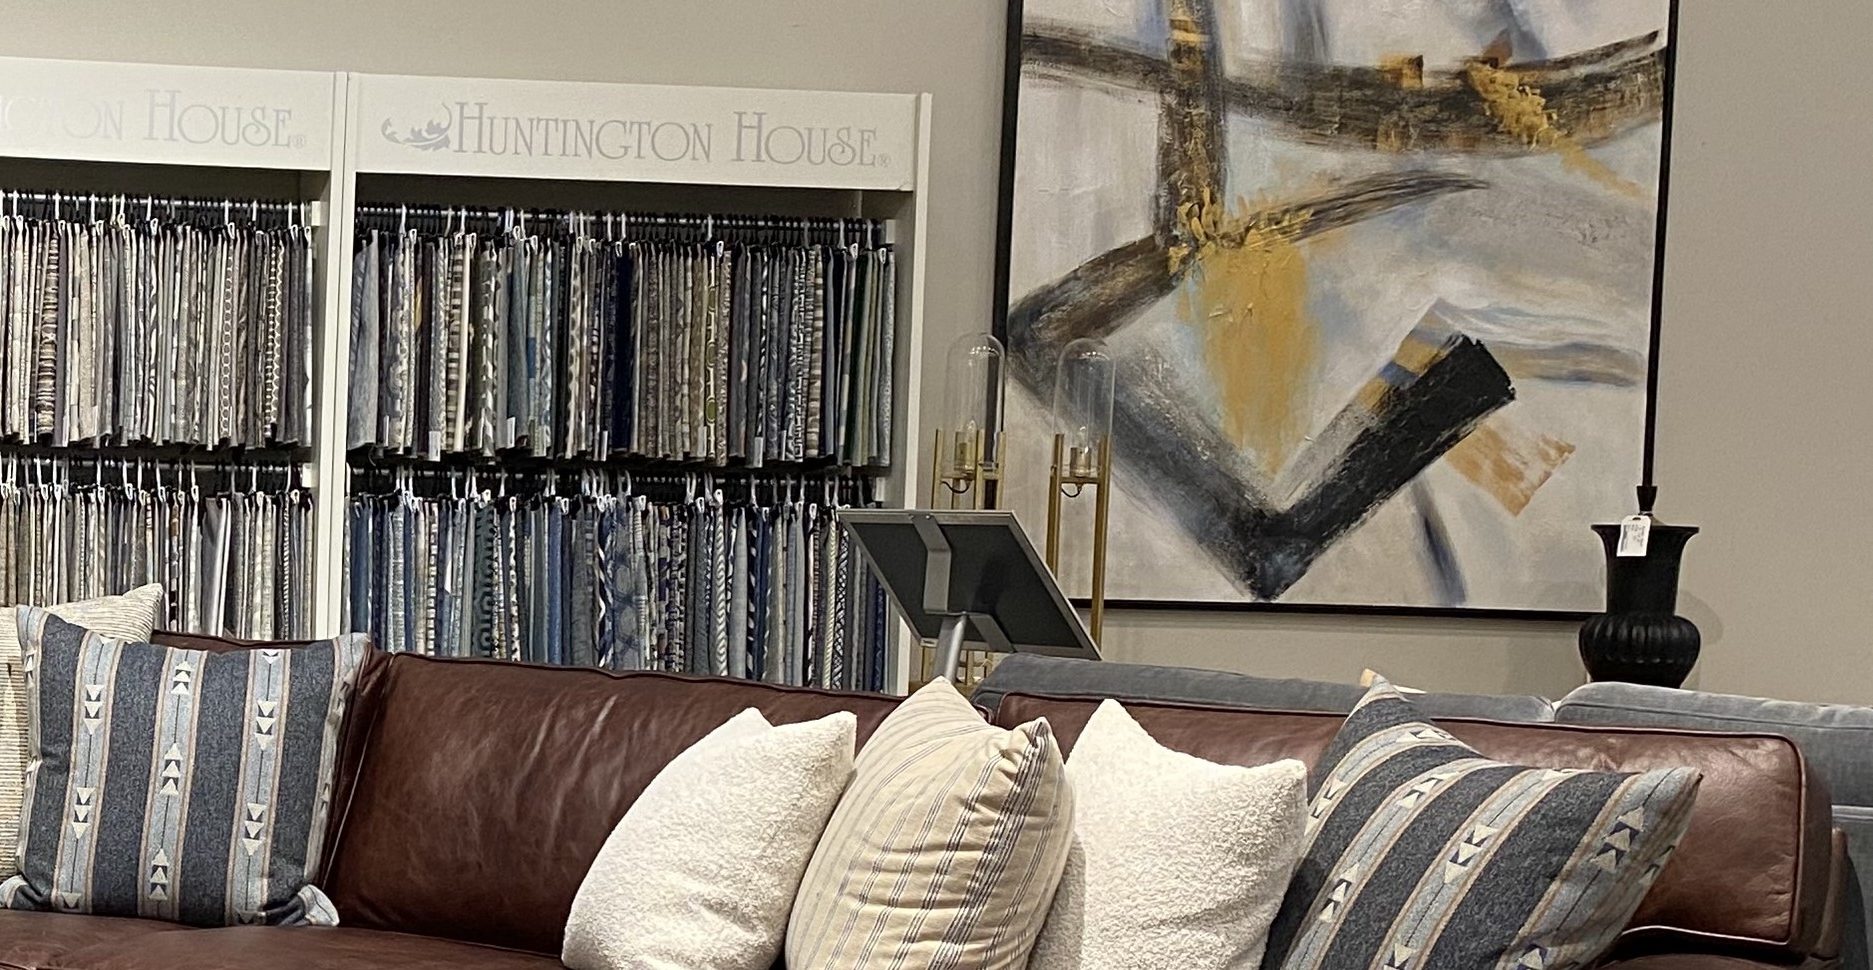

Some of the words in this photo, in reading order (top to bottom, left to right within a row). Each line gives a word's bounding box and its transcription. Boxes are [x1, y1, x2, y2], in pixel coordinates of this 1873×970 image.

[143, 89, 292, 148] HOUSE
[453, 102, 712, 162] HUNTINGTON
[731, 111, 878, 167] HOUSE
